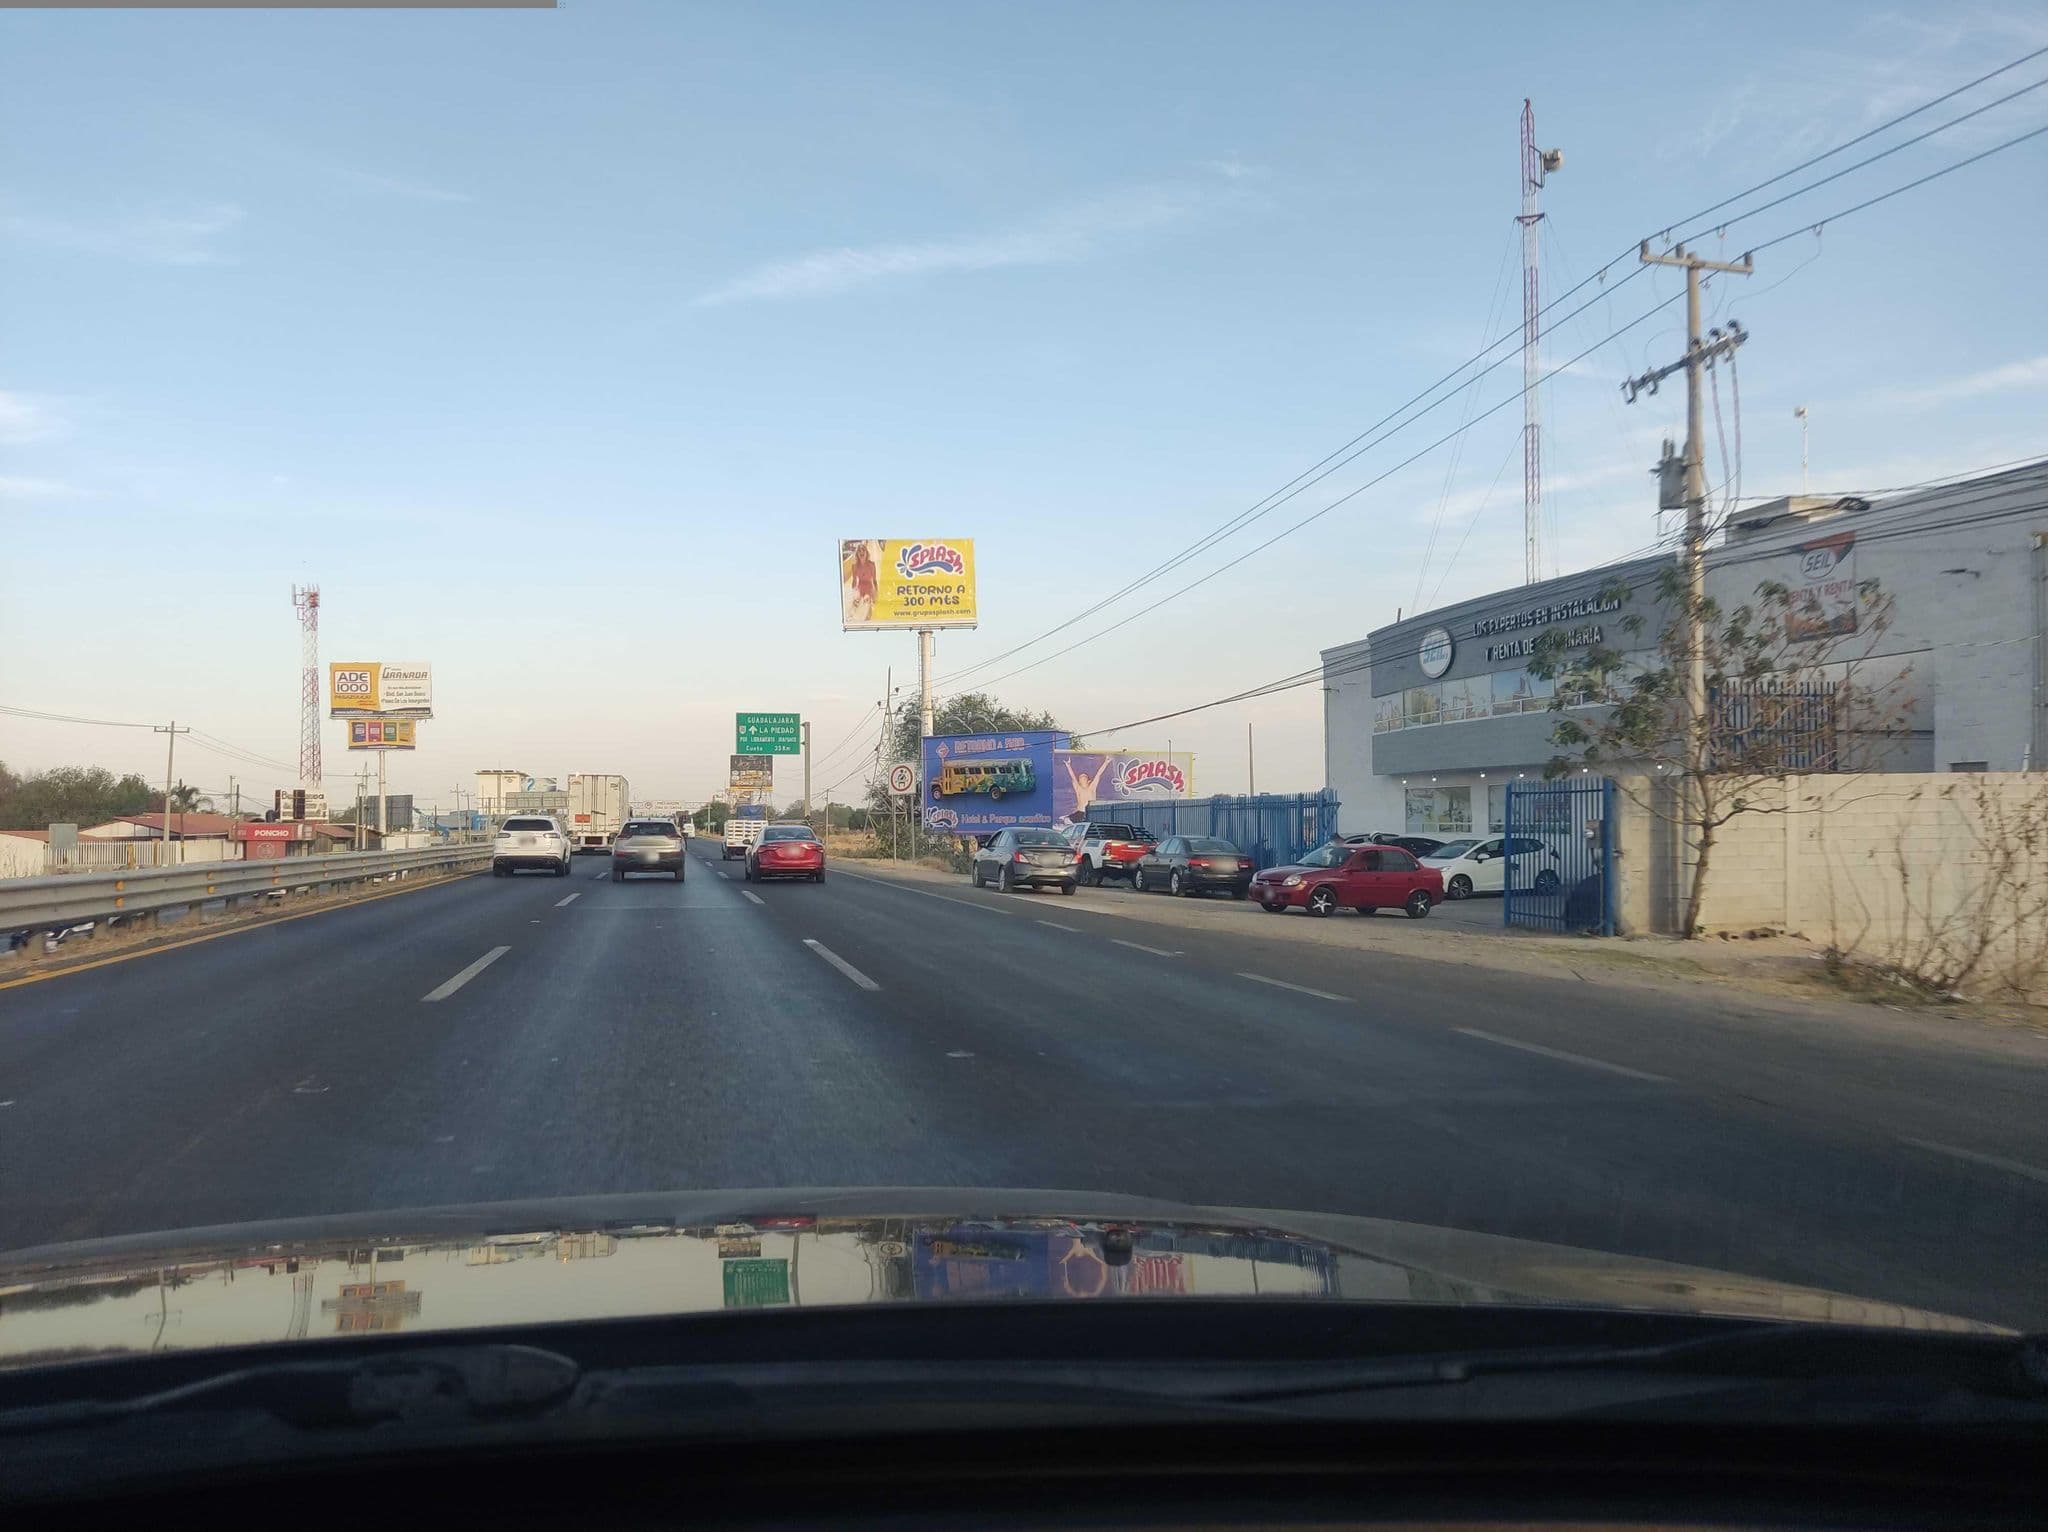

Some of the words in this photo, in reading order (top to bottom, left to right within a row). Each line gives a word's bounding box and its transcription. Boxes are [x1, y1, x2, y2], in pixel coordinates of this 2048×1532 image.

[908, 545, 964, 575] SPLASH
[1804, 551, 1831, 573] SEIL
[897, 585, 952, 596] RETORNO
[956, 584, 966, 595] A
[903, 597, 925, 607] 300
[1492, 640, 1521, 660] RENTA
[1521, 637, 1535, 655] DE
[338, 672, 369, 682] ADE
[382, 667, 428, 679] GRANADA
[336, 683, 369, 693] 1000
[1125, 760, 1185, 793] SPLASH
[254, 829, 289, 837] PONCHO
